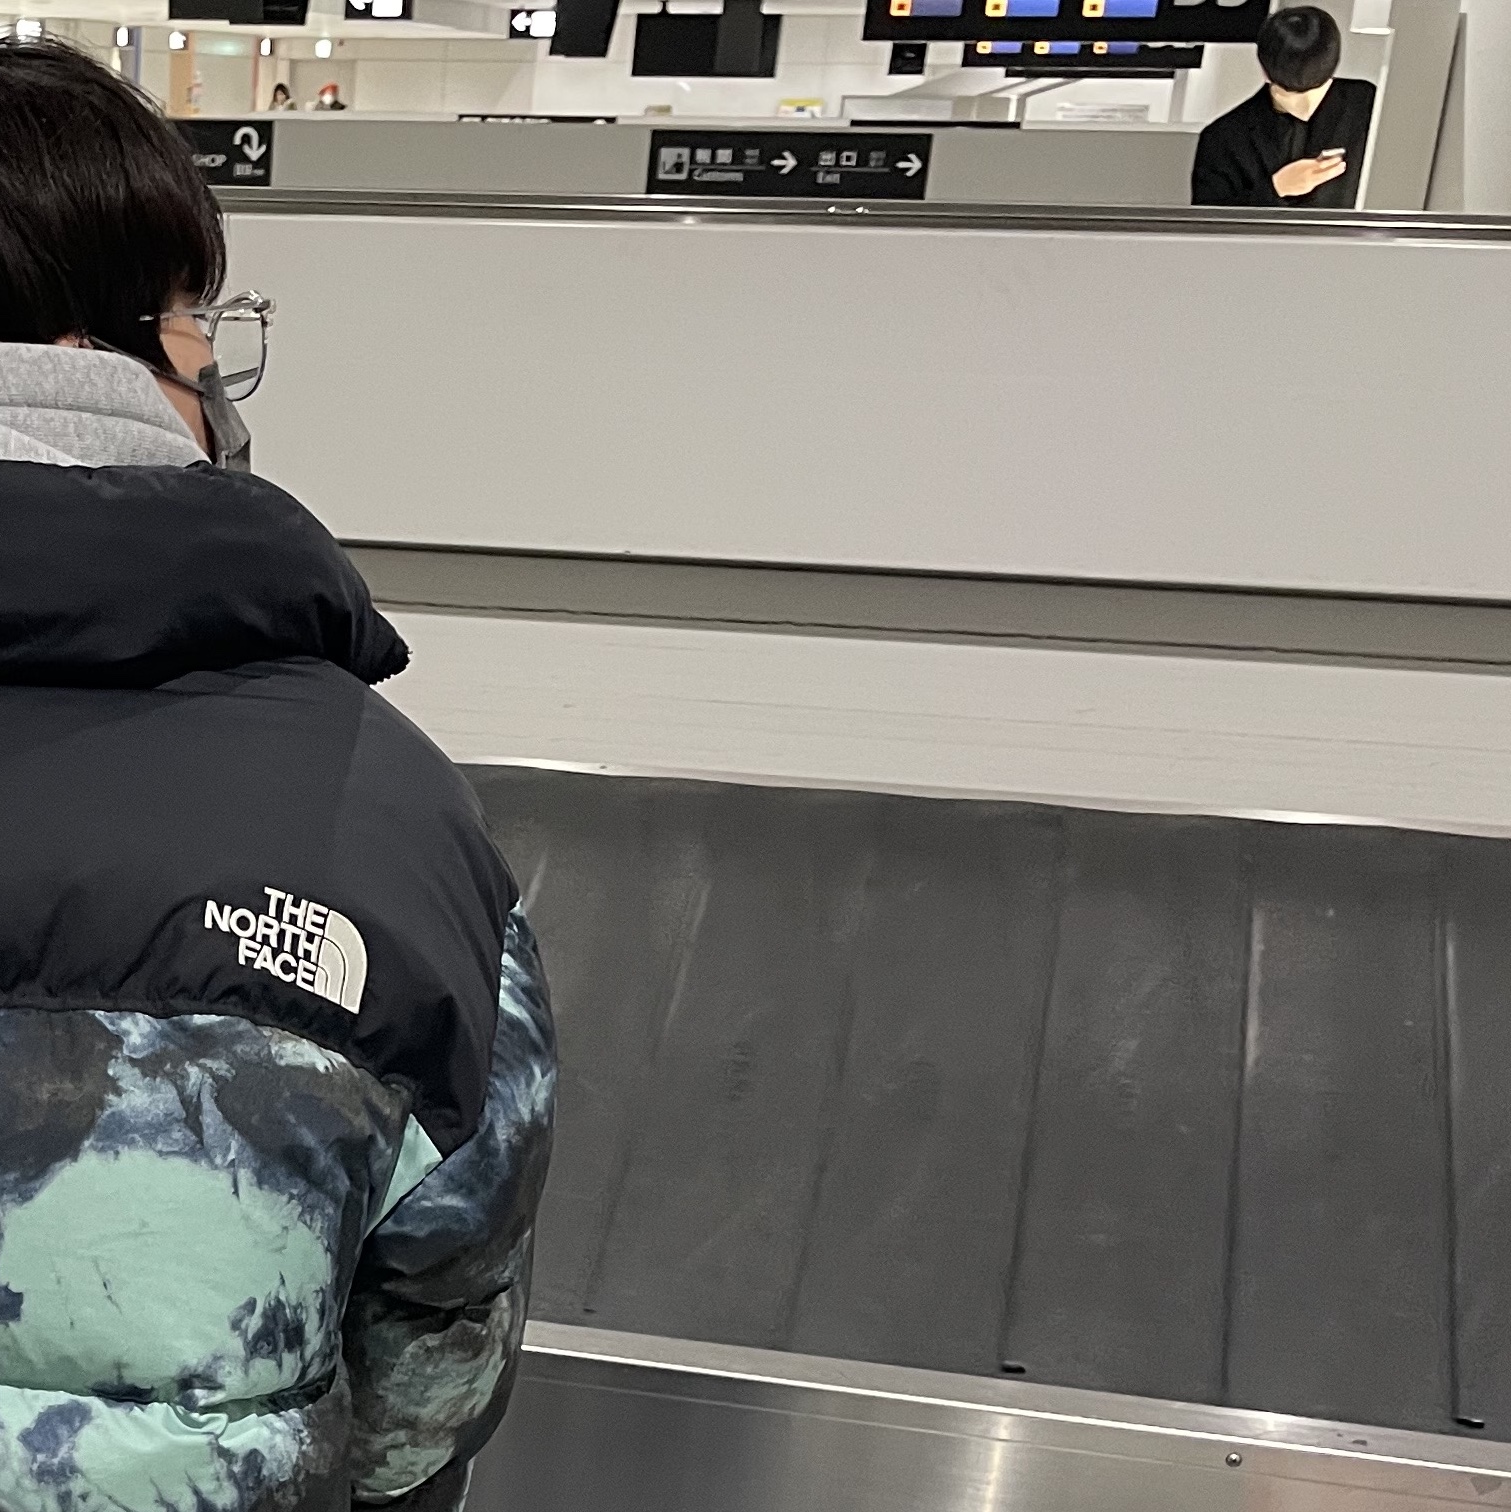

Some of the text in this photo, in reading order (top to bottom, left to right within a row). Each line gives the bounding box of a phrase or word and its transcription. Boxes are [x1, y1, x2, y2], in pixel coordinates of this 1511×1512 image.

[204, 899, 323, 964] NORTH
[264, 886, 328, 934] THE
[238, 937, 317, 993] FACE
